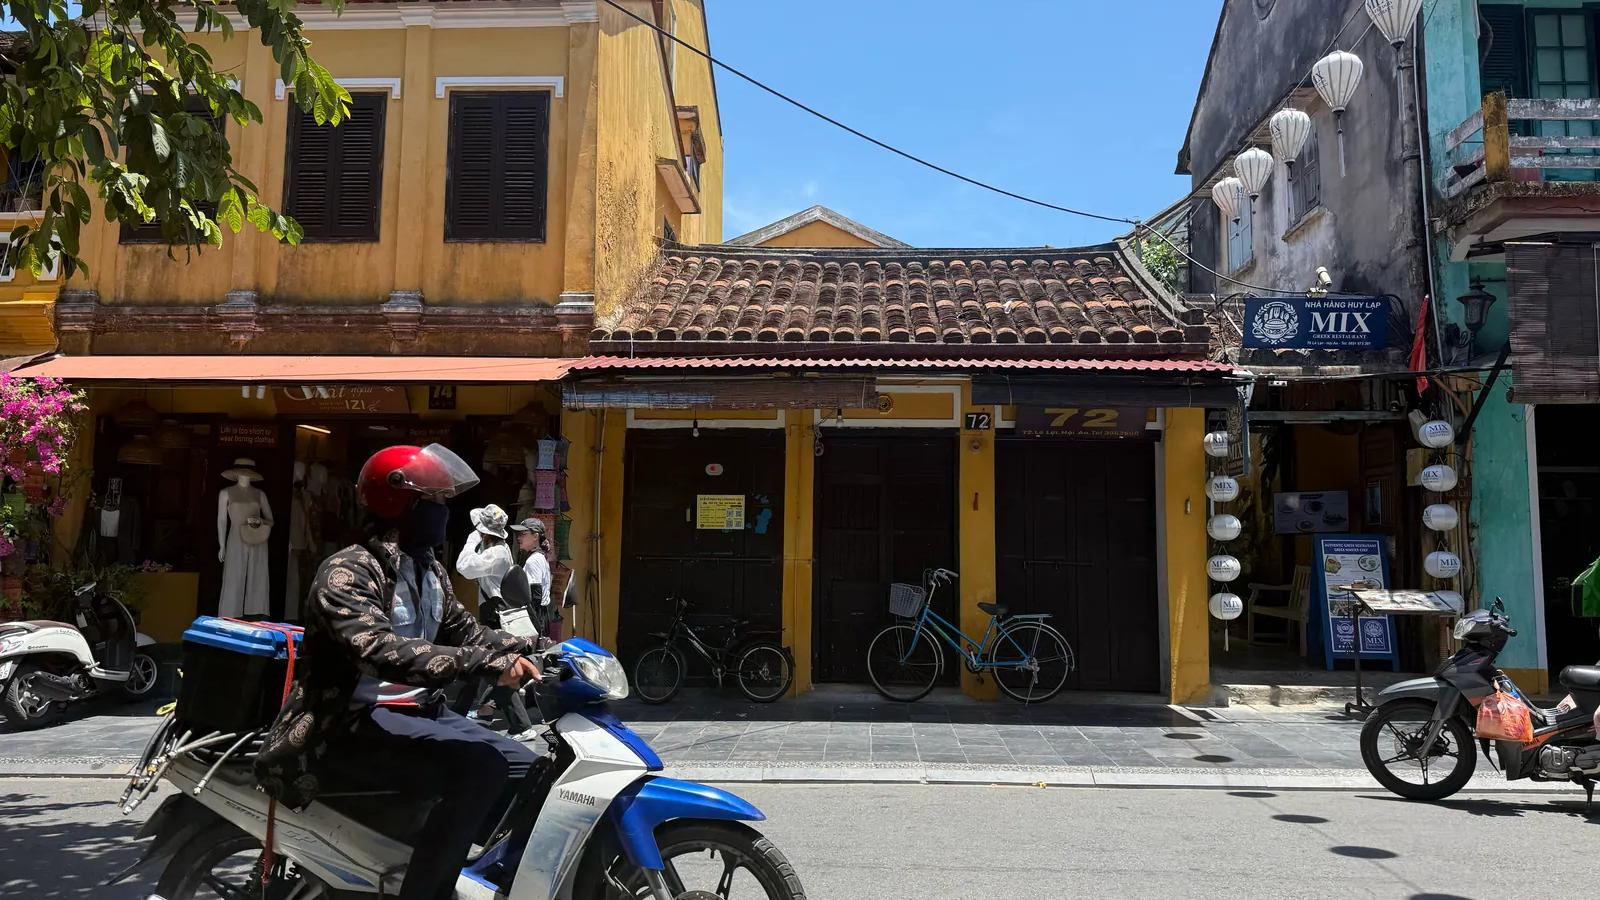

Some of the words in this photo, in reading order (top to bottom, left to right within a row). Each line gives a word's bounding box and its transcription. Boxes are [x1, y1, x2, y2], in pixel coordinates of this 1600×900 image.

[1305, 300, 1322, 308] NHÀ
[1323, 300, 1346, 309] HÀNG
[1347, 301, 1364, 309] HUY
[1365, 301, 1381, 310] LẠP
[1309, 312, 1372, 333] MIX
[433, 384, 453, 398] 74
[967, 414, 989, 428] 72
[1044, 407, 1119, 428] 72
[1429, 424, 1449, 433] MIX
[1214, 482, 1233, 490] MIX
[1211, 560, 1230, 568] MIX
[1440, 558, 1458, 566] MIX
[559, 788, 596, 806] YAMAHA
